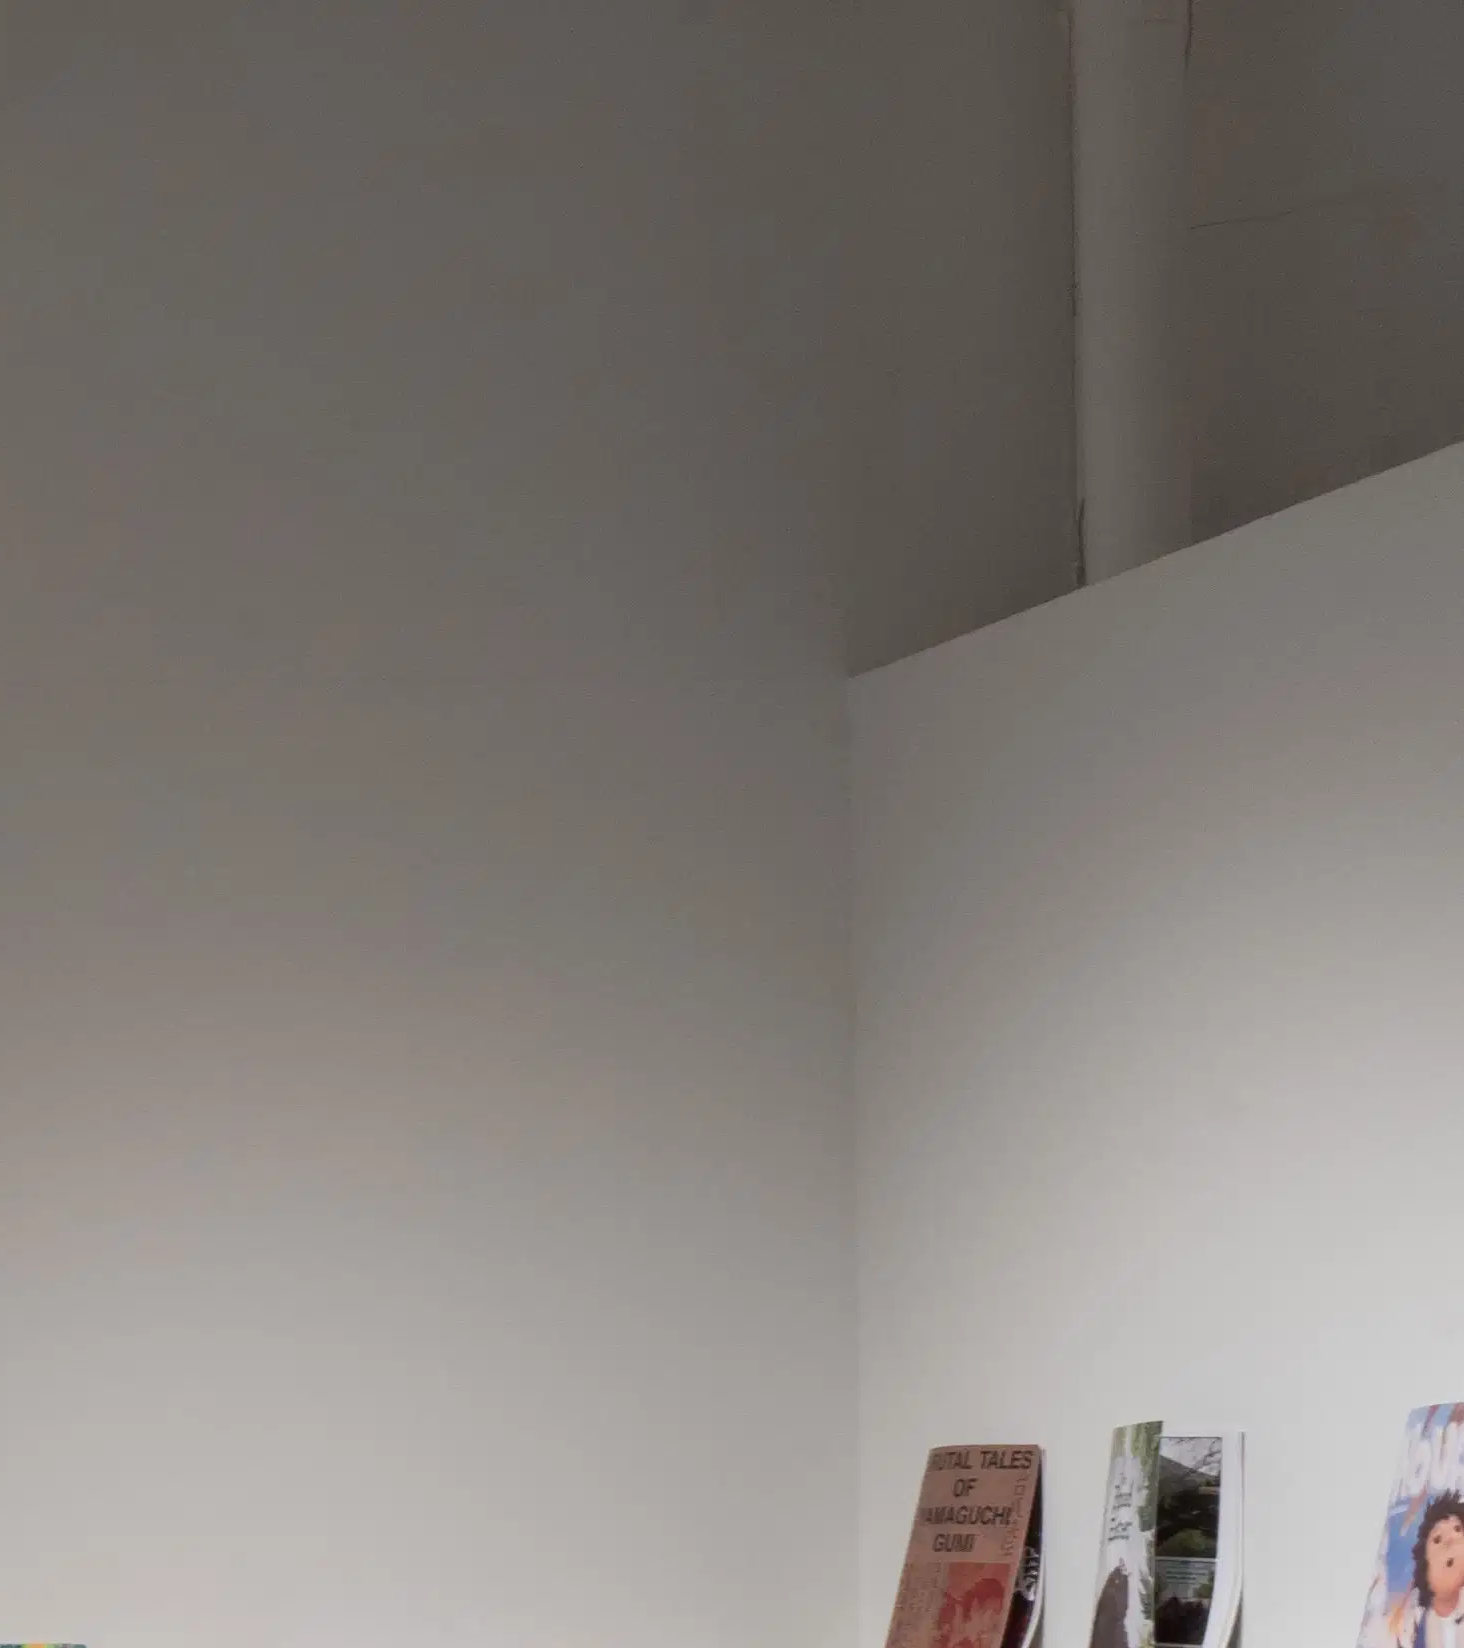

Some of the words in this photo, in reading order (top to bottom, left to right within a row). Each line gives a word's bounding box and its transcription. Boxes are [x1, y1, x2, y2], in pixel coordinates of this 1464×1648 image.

[980, 1450, 1034, 1470] TALES
[953, 1478, 979, 1498] OF
[919, 1505, 1012, 1526] AMAGUCHI
[932, 1534, 977, 1552] GUMI
